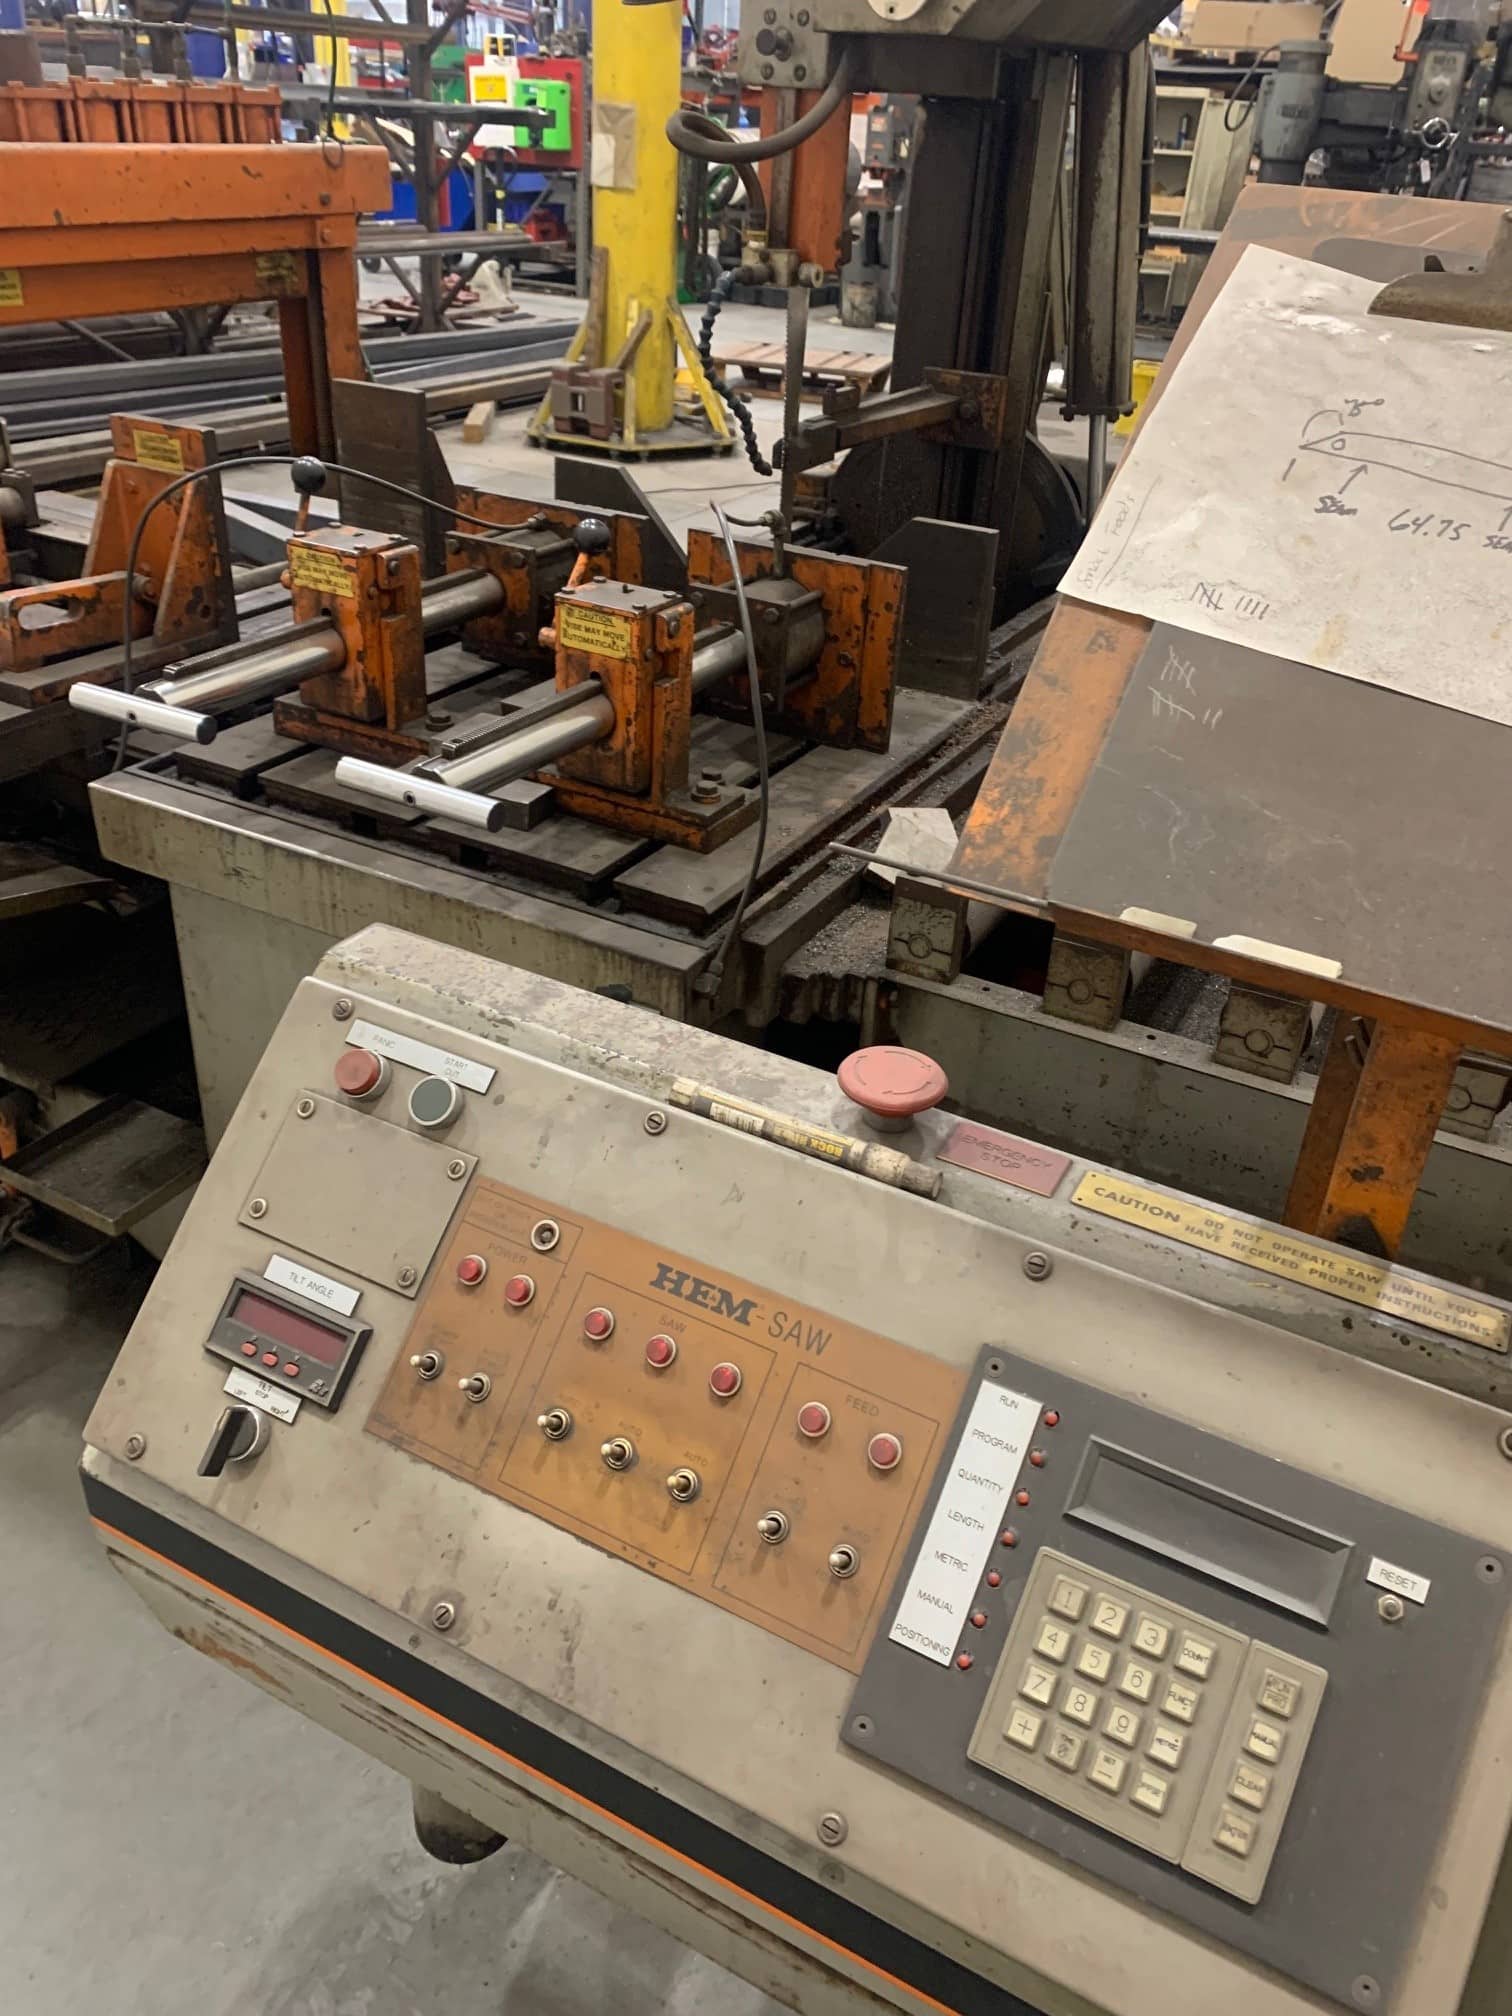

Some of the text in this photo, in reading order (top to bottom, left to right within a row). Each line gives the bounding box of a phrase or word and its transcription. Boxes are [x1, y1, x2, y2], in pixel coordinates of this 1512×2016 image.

[1388, 508, 1471, 542] 64.75
[602, 629, 625, 642] MOVE
[960, 1135, 1053, 1168] EMERGENCY
[981, 1152, 1021, 1169] STOP
[1094, 1187, 1479, 1318] CAUTION DO NOT OPERATE SAW UNTIL YOU
[307, 1281, 335, 1299] ANGLE
[1184, 1224, 1491, 1338] HAVE RECEIVED PROPER INSTRUCTIONS
[657, 1314, 687, 1334] SAW
[846, 1394, 879, 1417] FEED
[1000, 1394, 1019, 1409] RUN
[972, 1428, 1018, 1454] PROGRAM
[957, 1468, 1004, 1493] QUANTITY
[947, 1509, 985, 1530] LENGTH
[934, 1550, 969, 1573] METRIC
[1380, 1568, 1418, 1591] RESET
[917, 1588, 954, 1615] MANUAL
[1101, 1606, 1117, 1627] 2
[894, 1623, 951, 1657] POSITIONING
[1047, 1632, 1058, 1649] 4
[1143, 1627, 1159, 1647] 3
[1088, 1649, 1102, 1668] 5
[1031, 1674, 1047, 1690] 7
[1131, 1670, 1144, 1688] 6
[1073, 1694, 1087, 1712] 8
[1115, 1714, 1129, 1734] 9
